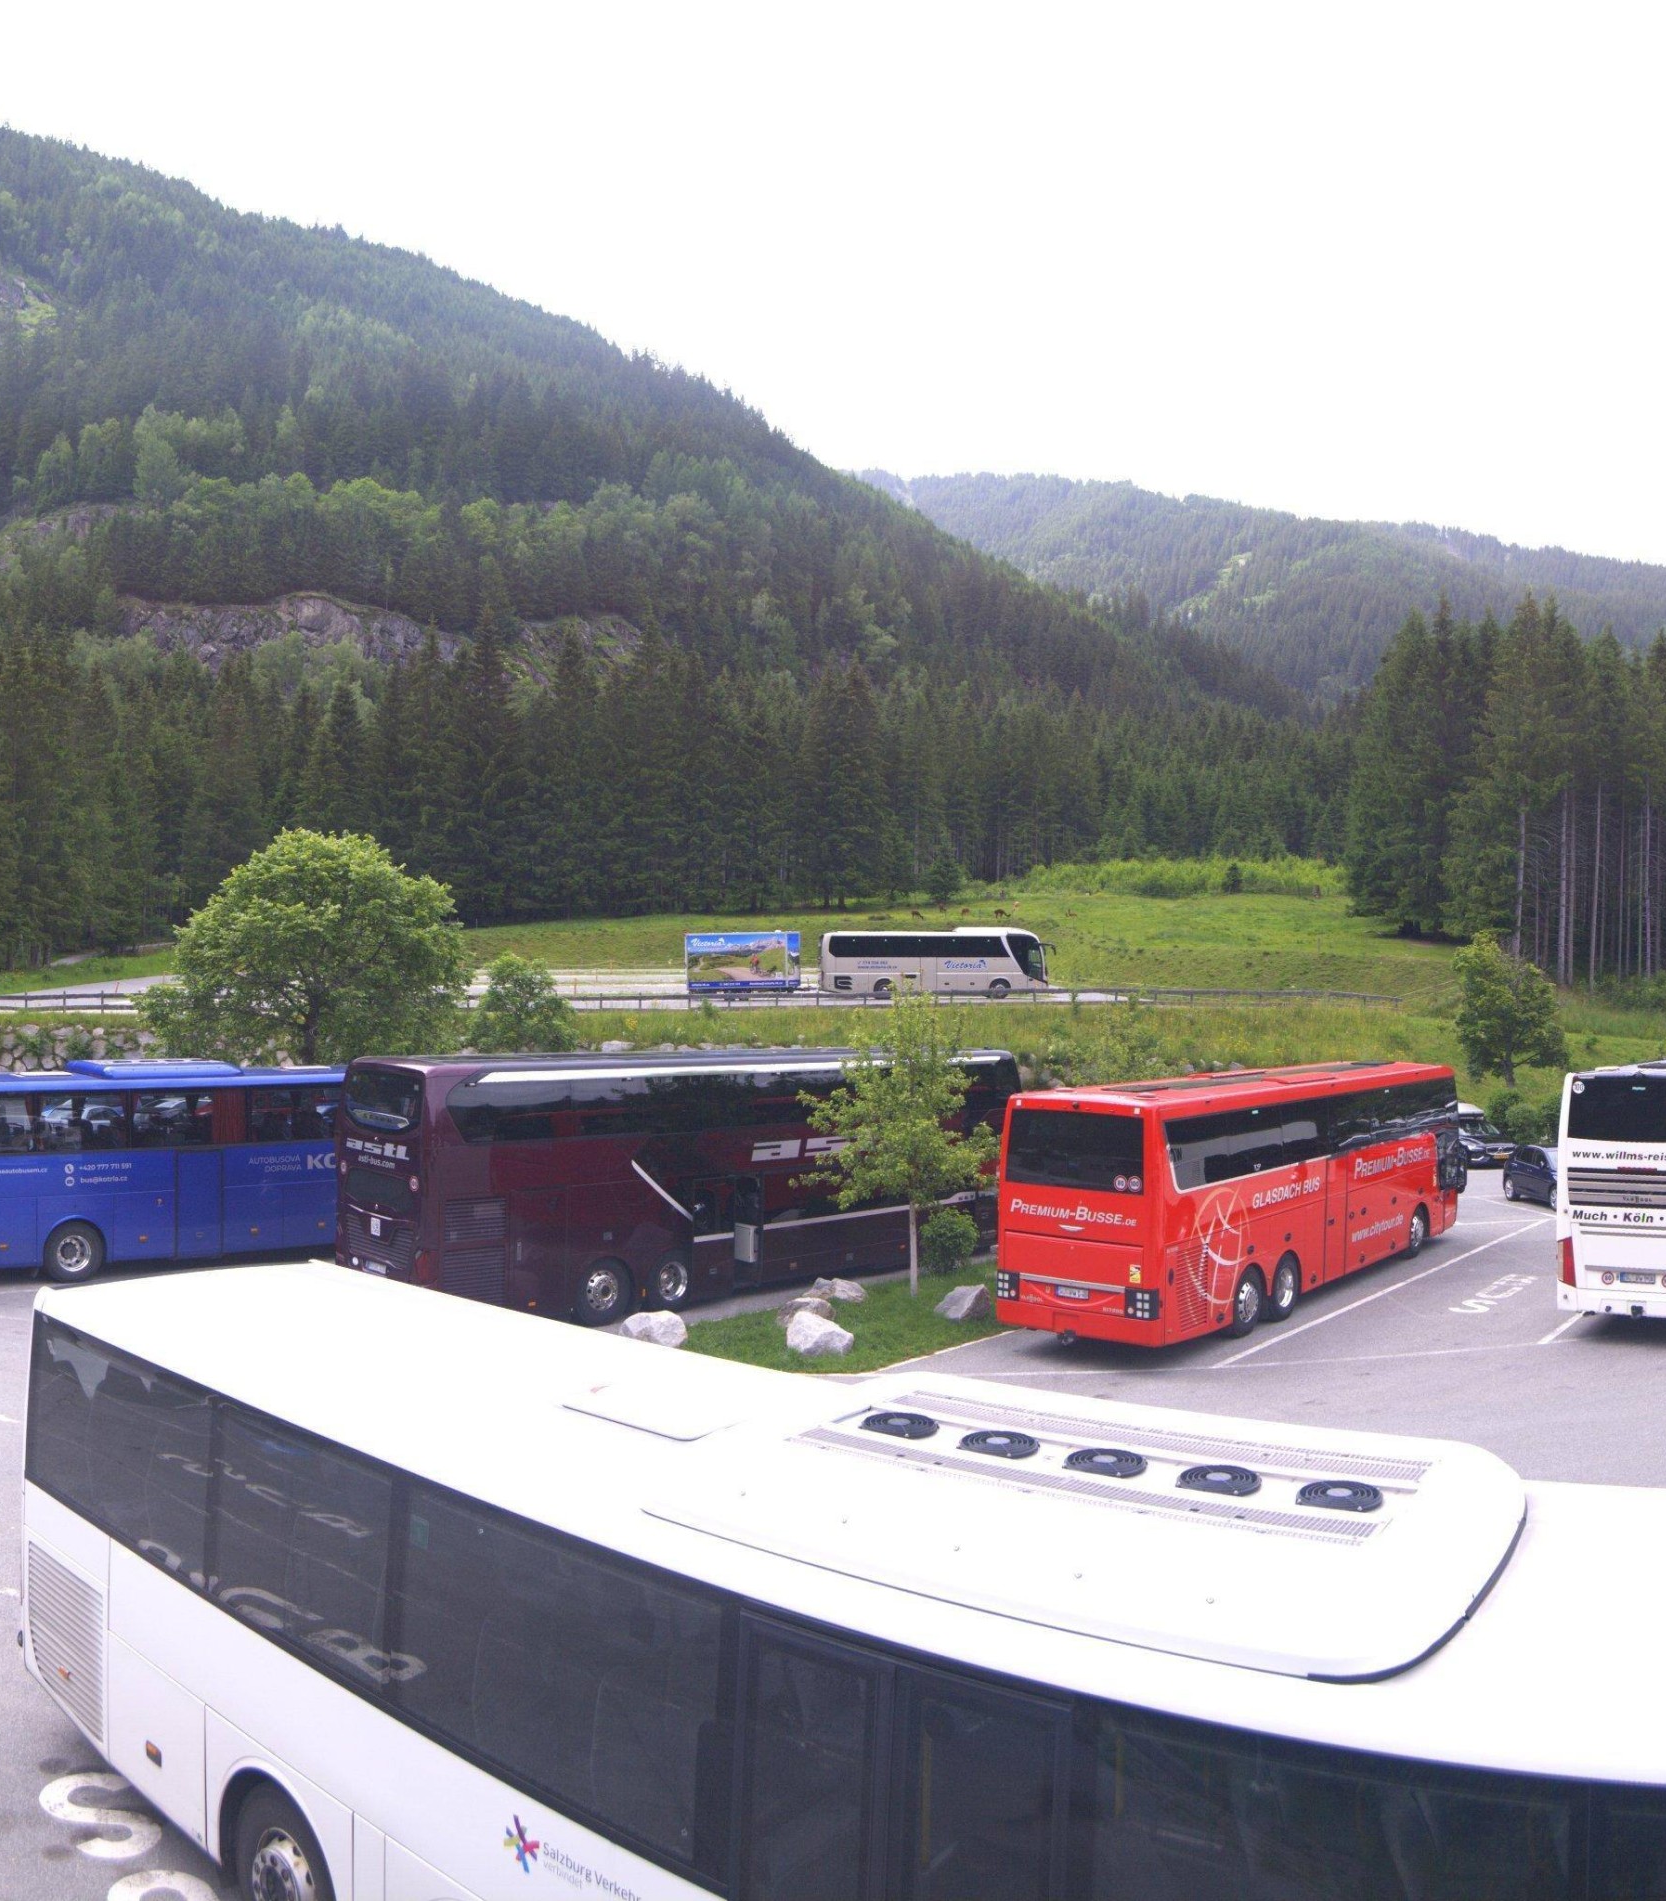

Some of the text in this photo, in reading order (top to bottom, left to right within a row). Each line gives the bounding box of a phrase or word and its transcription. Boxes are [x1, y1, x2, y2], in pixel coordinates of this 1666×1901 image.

[690, 938, 722, 947] Victoria
[944, 959, 982, 970] Victoria
[1252, 1176, 1321, 1210] GLASDACH BUS
[1572, 1209, 1608, 1222] Much
[1622, 1211, 1654, 1223] Köln
[1351, 1213, 1405, 1243] www.citytour.de
[542, 1841, 593, 1884] Salzburg
